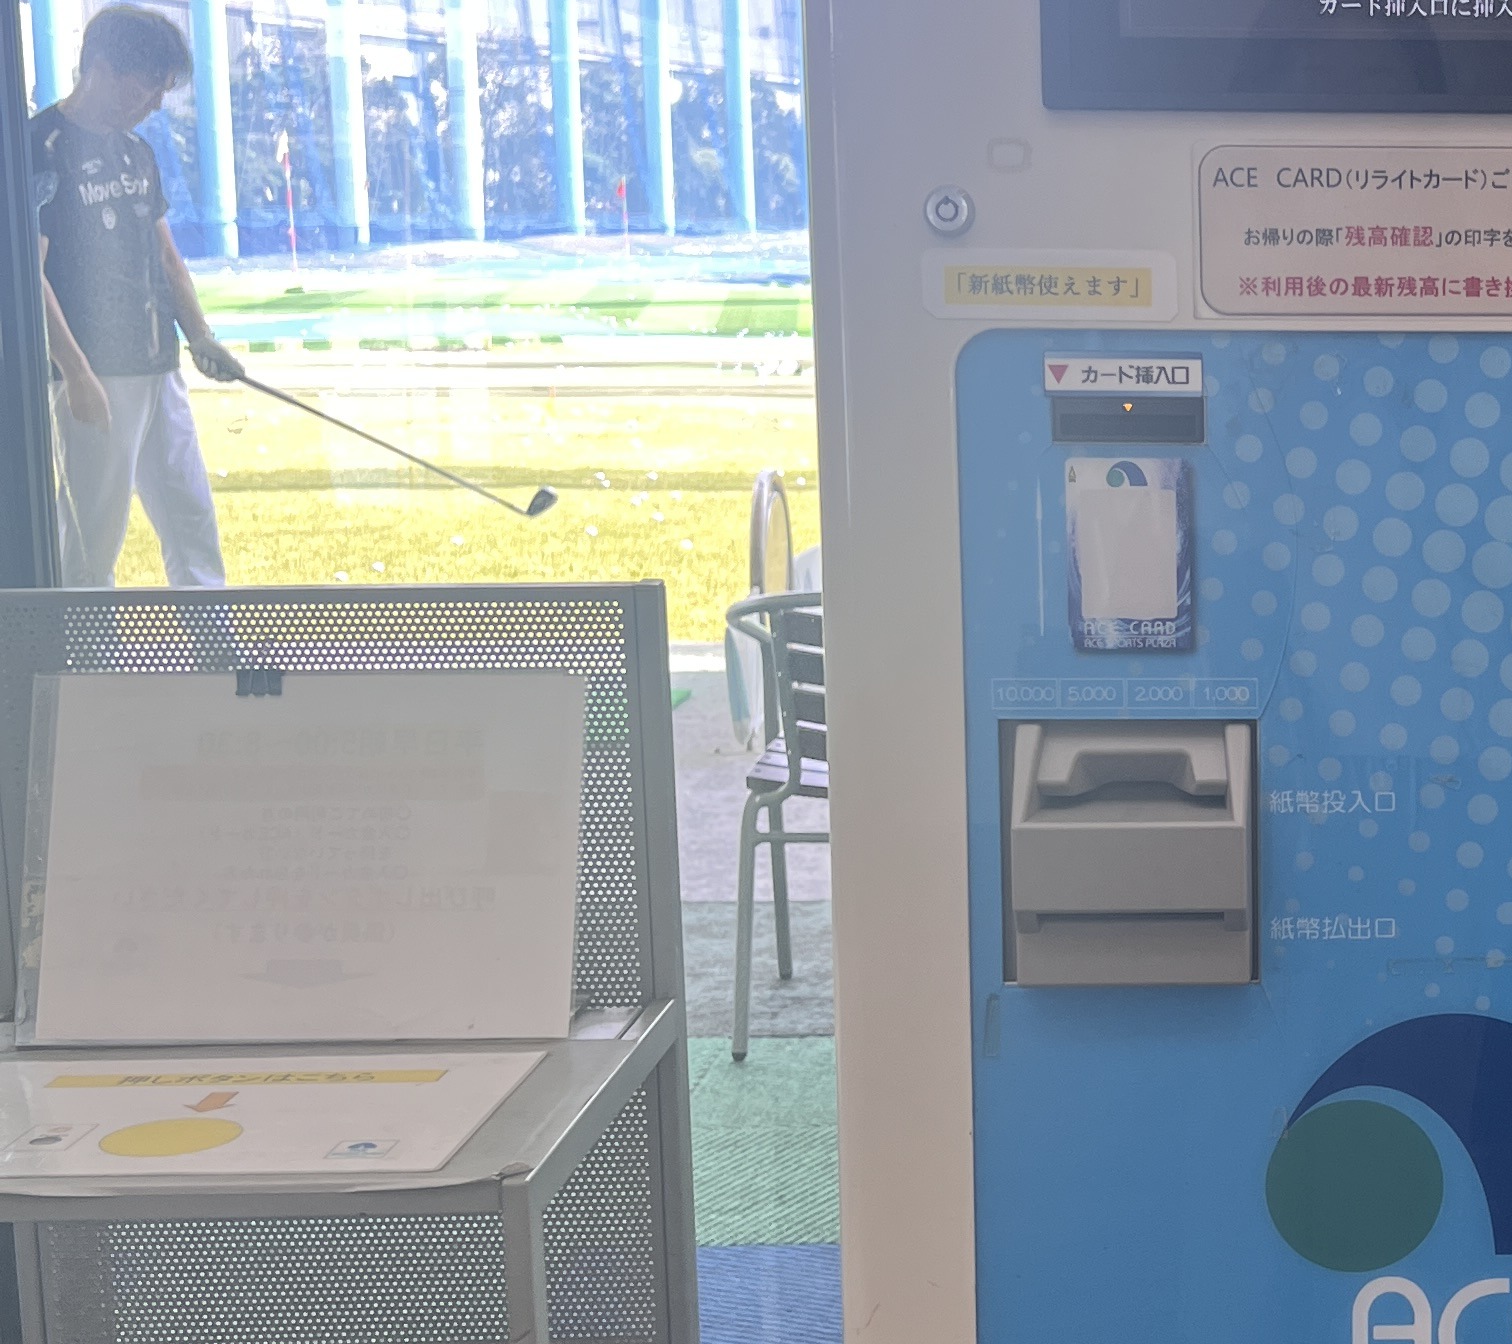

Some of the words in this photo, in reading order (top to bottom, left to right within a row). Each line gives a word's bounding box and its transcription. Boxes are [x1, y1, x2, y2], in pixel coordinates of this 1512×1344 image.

[1213, 168, 1258, 188] ACE
[955, 272, 1140, 298] 「新紙幣使えます」
[1081, 364, 1190, 385] カード挿入口
[1130, 621, 1176, 635] CARD
[1269, 790, 1396, 814] 紙幣投入口
[1270, 916, 1396, 940] 紙幣払出口
[119, 1072, 377, 1087] 押しボタンはこちら
